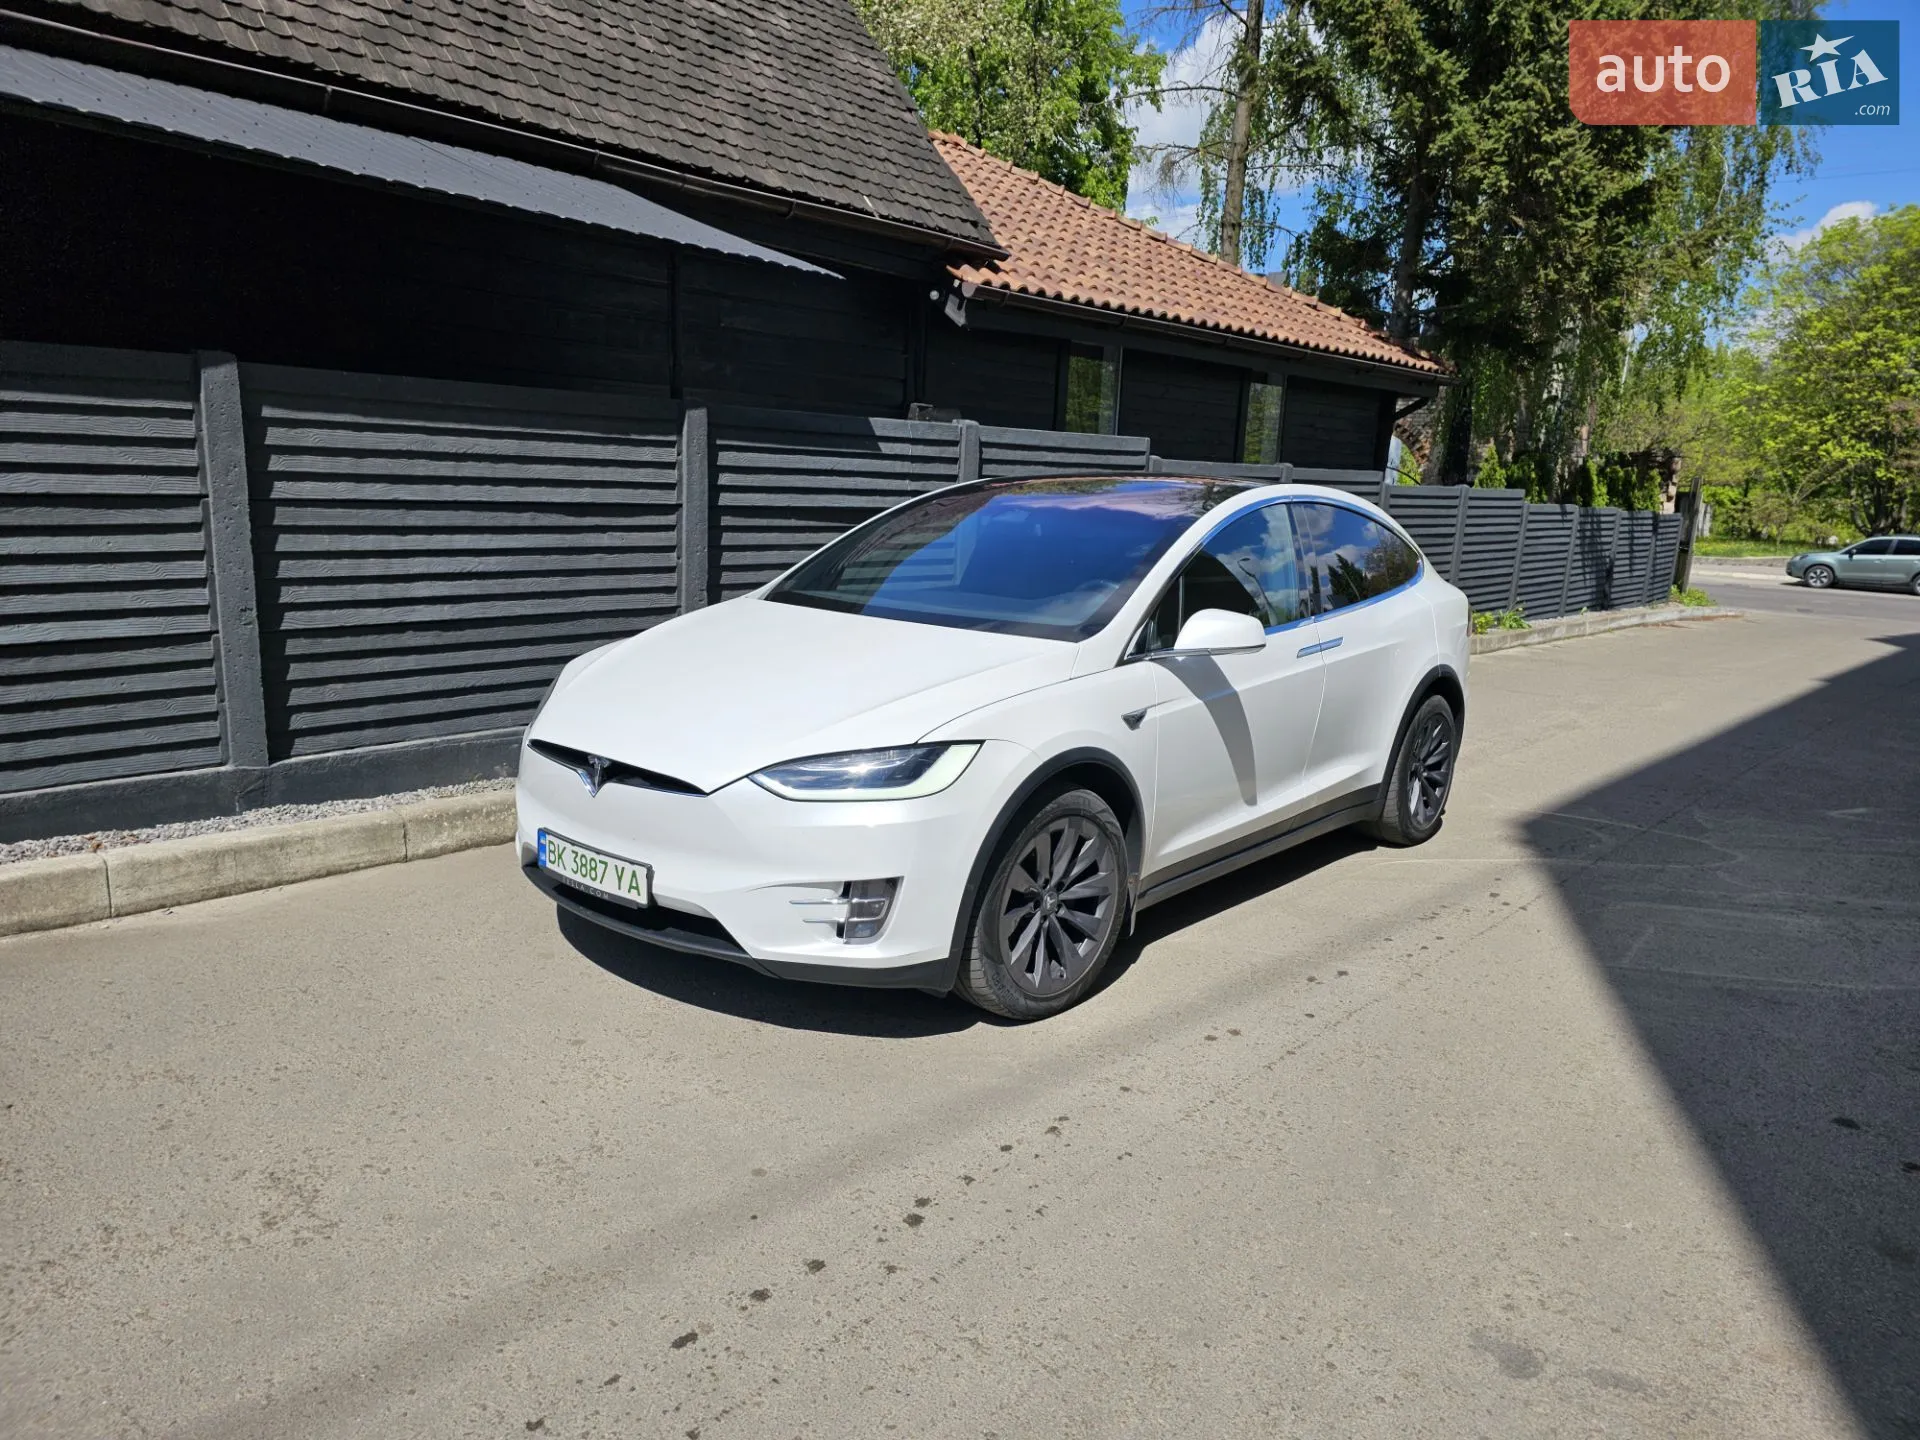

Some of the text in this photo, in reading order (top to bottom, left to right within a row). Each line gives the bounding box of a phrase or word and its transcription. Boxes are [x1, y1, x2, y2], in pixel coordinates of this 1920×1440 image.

[548, 839, 641, 897] BK 3887 YA
